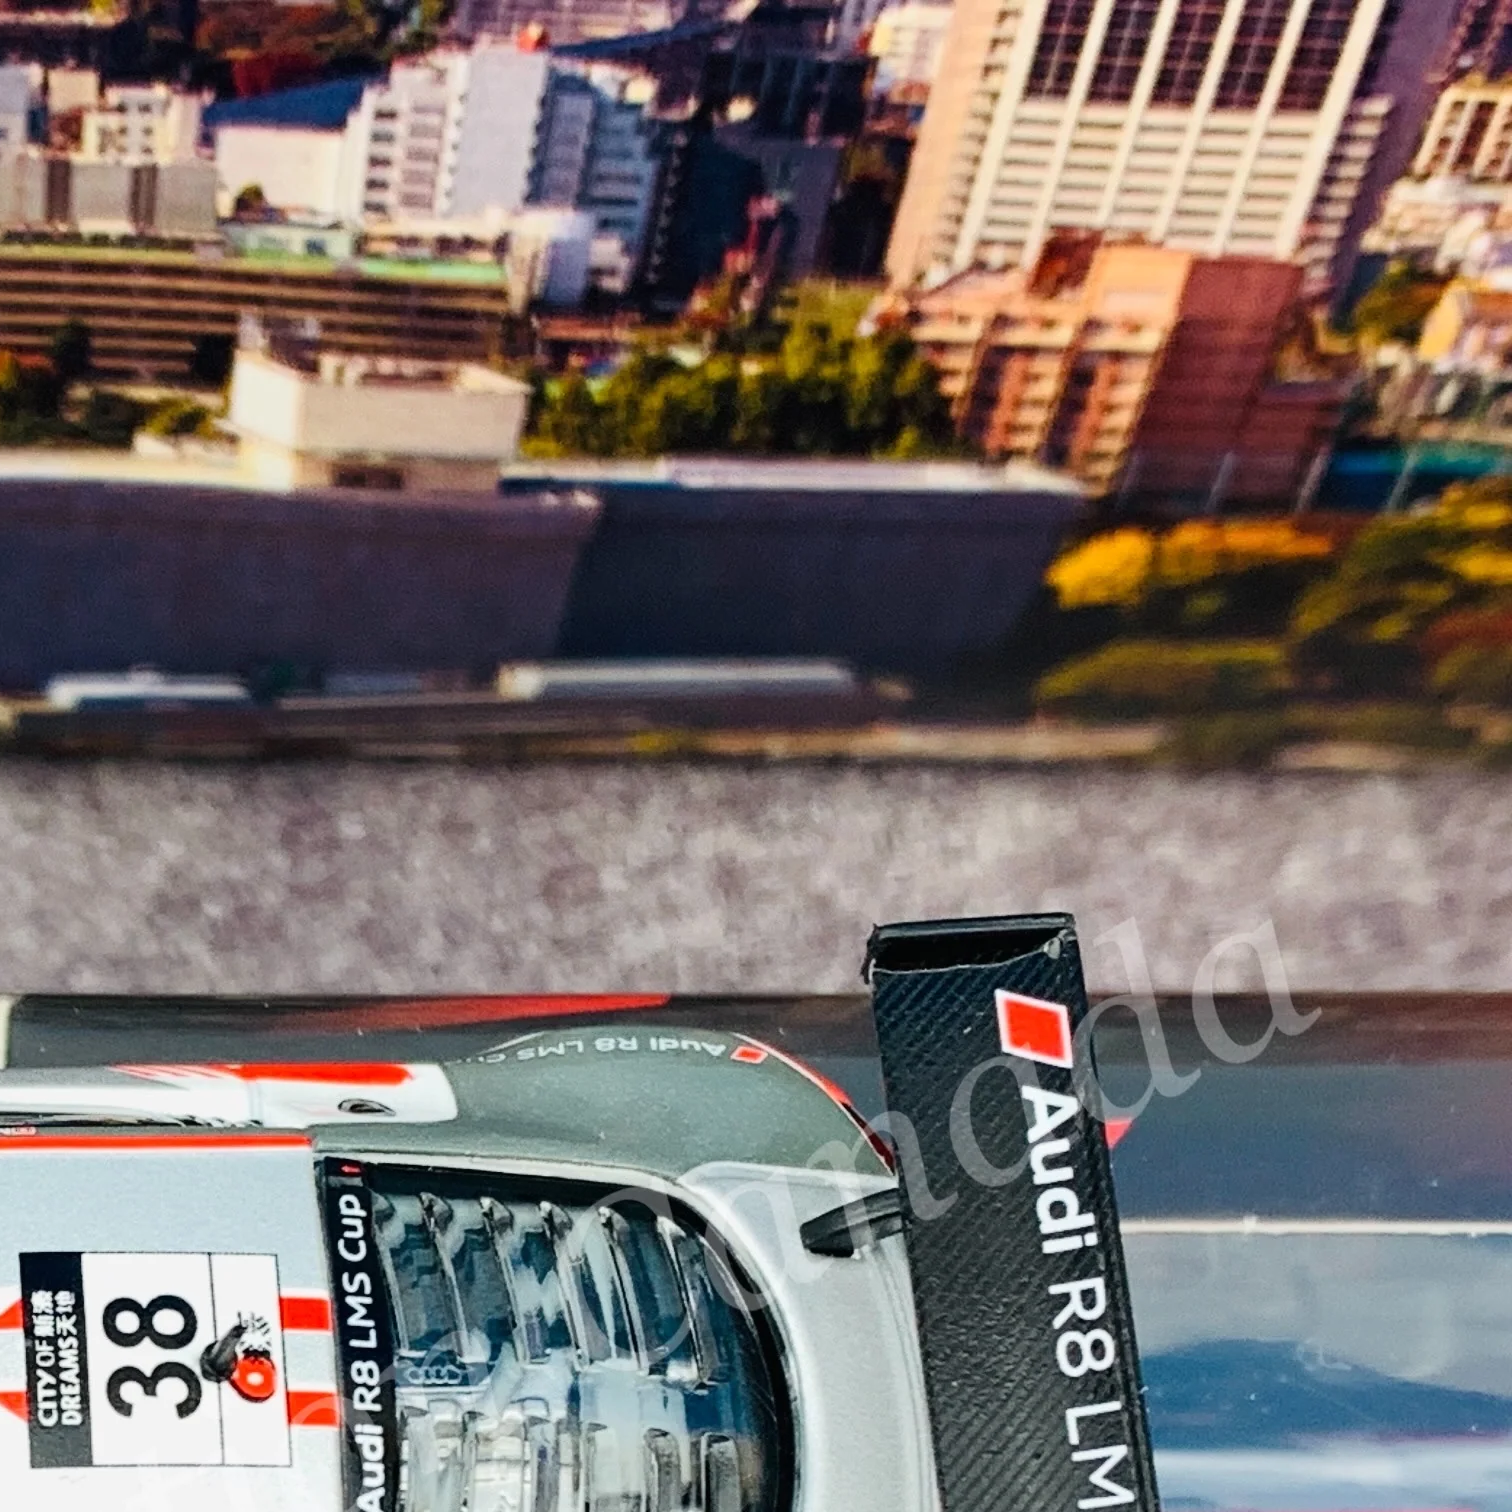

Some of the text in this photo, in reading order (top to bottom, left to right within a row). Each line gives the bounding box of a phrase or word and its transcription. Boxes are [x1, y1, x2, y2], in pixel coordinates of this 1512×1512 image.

[650, 1036, 727, 1058] Audi
[1020, 1083, 1098, 1256] Audi
[338, 1194, 367, 1262] Cup
[342, 1272, 378, 1349] LMS
[1047, 1279, 1116, 1380] R8
[35, 1339, 56, 1368] OF
[57, 1336, 83, 1426] DREAMS
[102, 1294, 202, 1420] 38
[350, 1360, 382, 1412] R8
[36, 1368, 59, 1427] CITY
